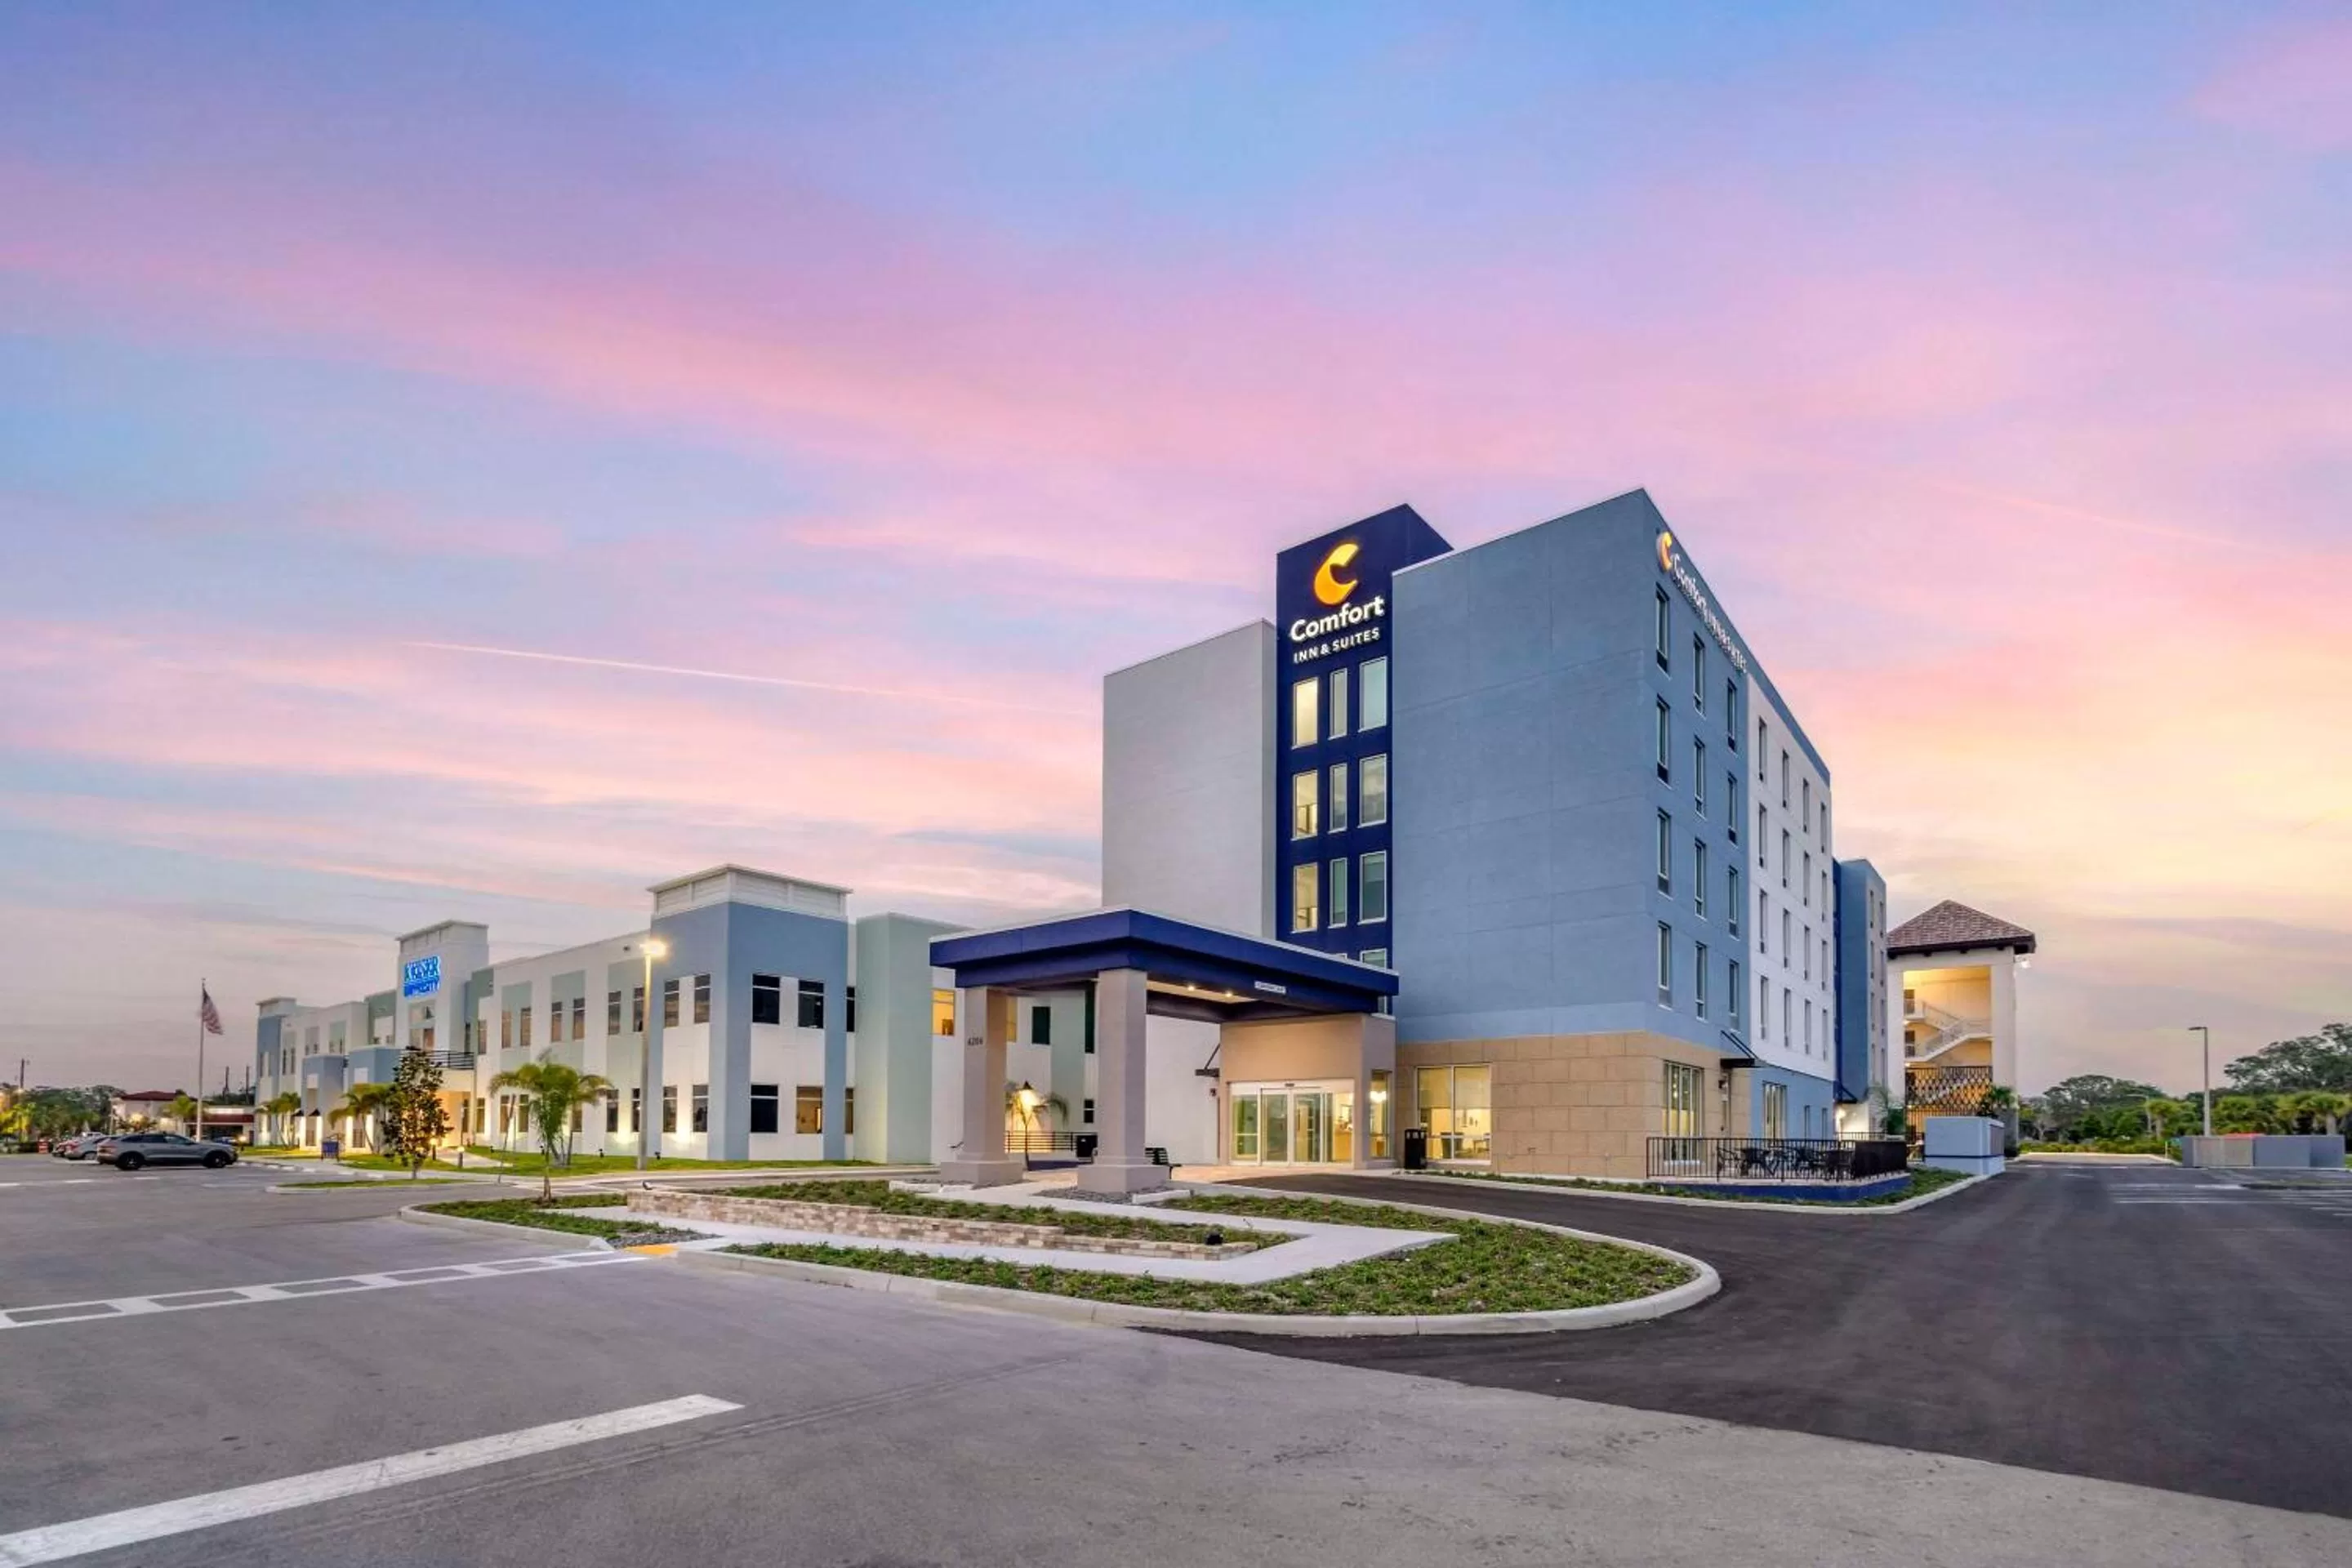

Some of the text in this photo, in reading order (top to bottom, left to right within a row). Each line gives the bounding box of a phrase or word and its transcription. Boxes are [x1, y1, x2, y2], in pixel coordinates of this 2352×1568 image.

[1290, 595, 1385, 642] Comfort
[1294, 627, 1380, 663] INN & SUITES
